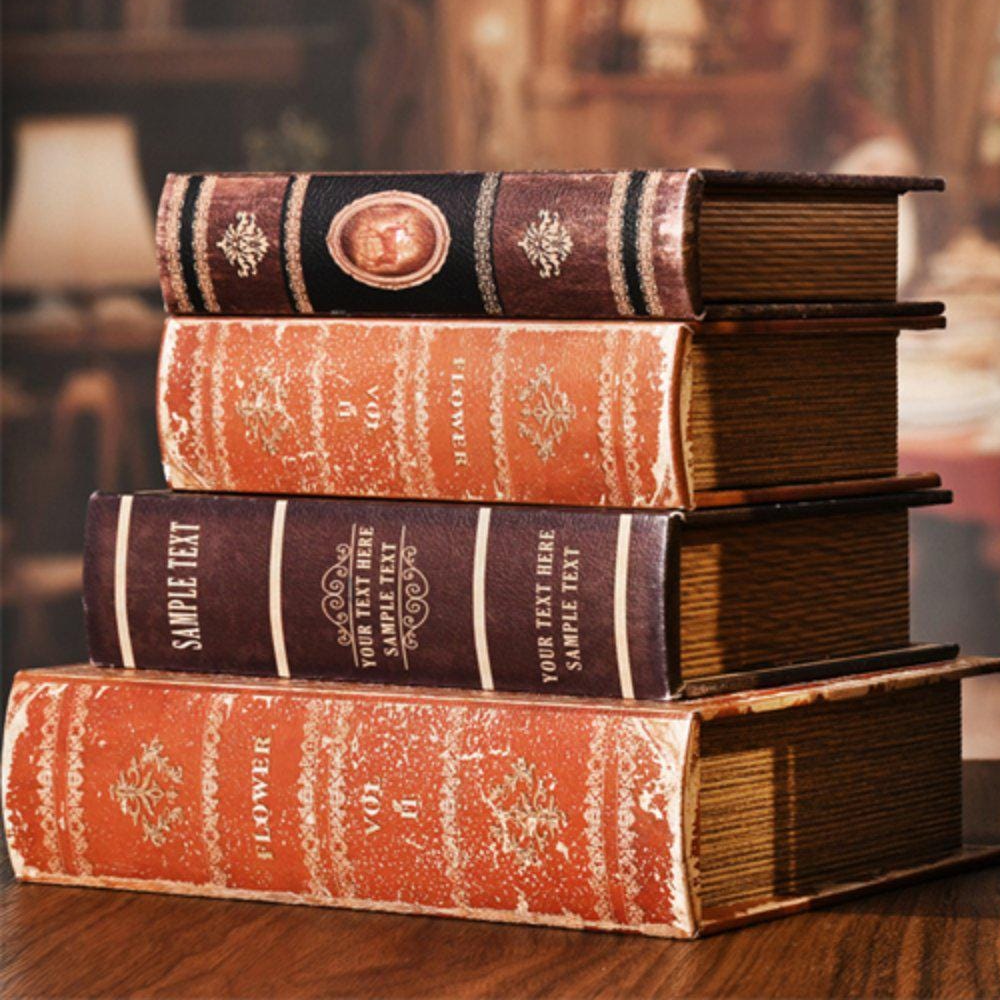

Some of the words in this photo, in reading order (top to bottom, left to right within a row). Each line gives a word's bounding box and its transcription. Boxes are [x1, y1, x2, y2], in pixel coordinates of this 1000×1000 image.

[450, 357, 468, 467] FLOWER
[167, 521, 200, 569] TEXT
[355, 524, 375, 570] HERE
[379, 541, 397, 584] TEXT
[535, 529, 556, 576] HERE
[562, 546, 581, 592] TEXT
[167, 576, 203, 650] SAMPLE
[355, 575, 372, 619] TEXT
[535, 583, 553, 629] TEXT
[355, 623, 377, 669] YOUR
[379, 590, 399, 657] SAMPLE
[562, 600, 583, 671] SAMPLE
[536, 637, 559, 684] YOUR
[251, 736, 274, 861] FLOWER
